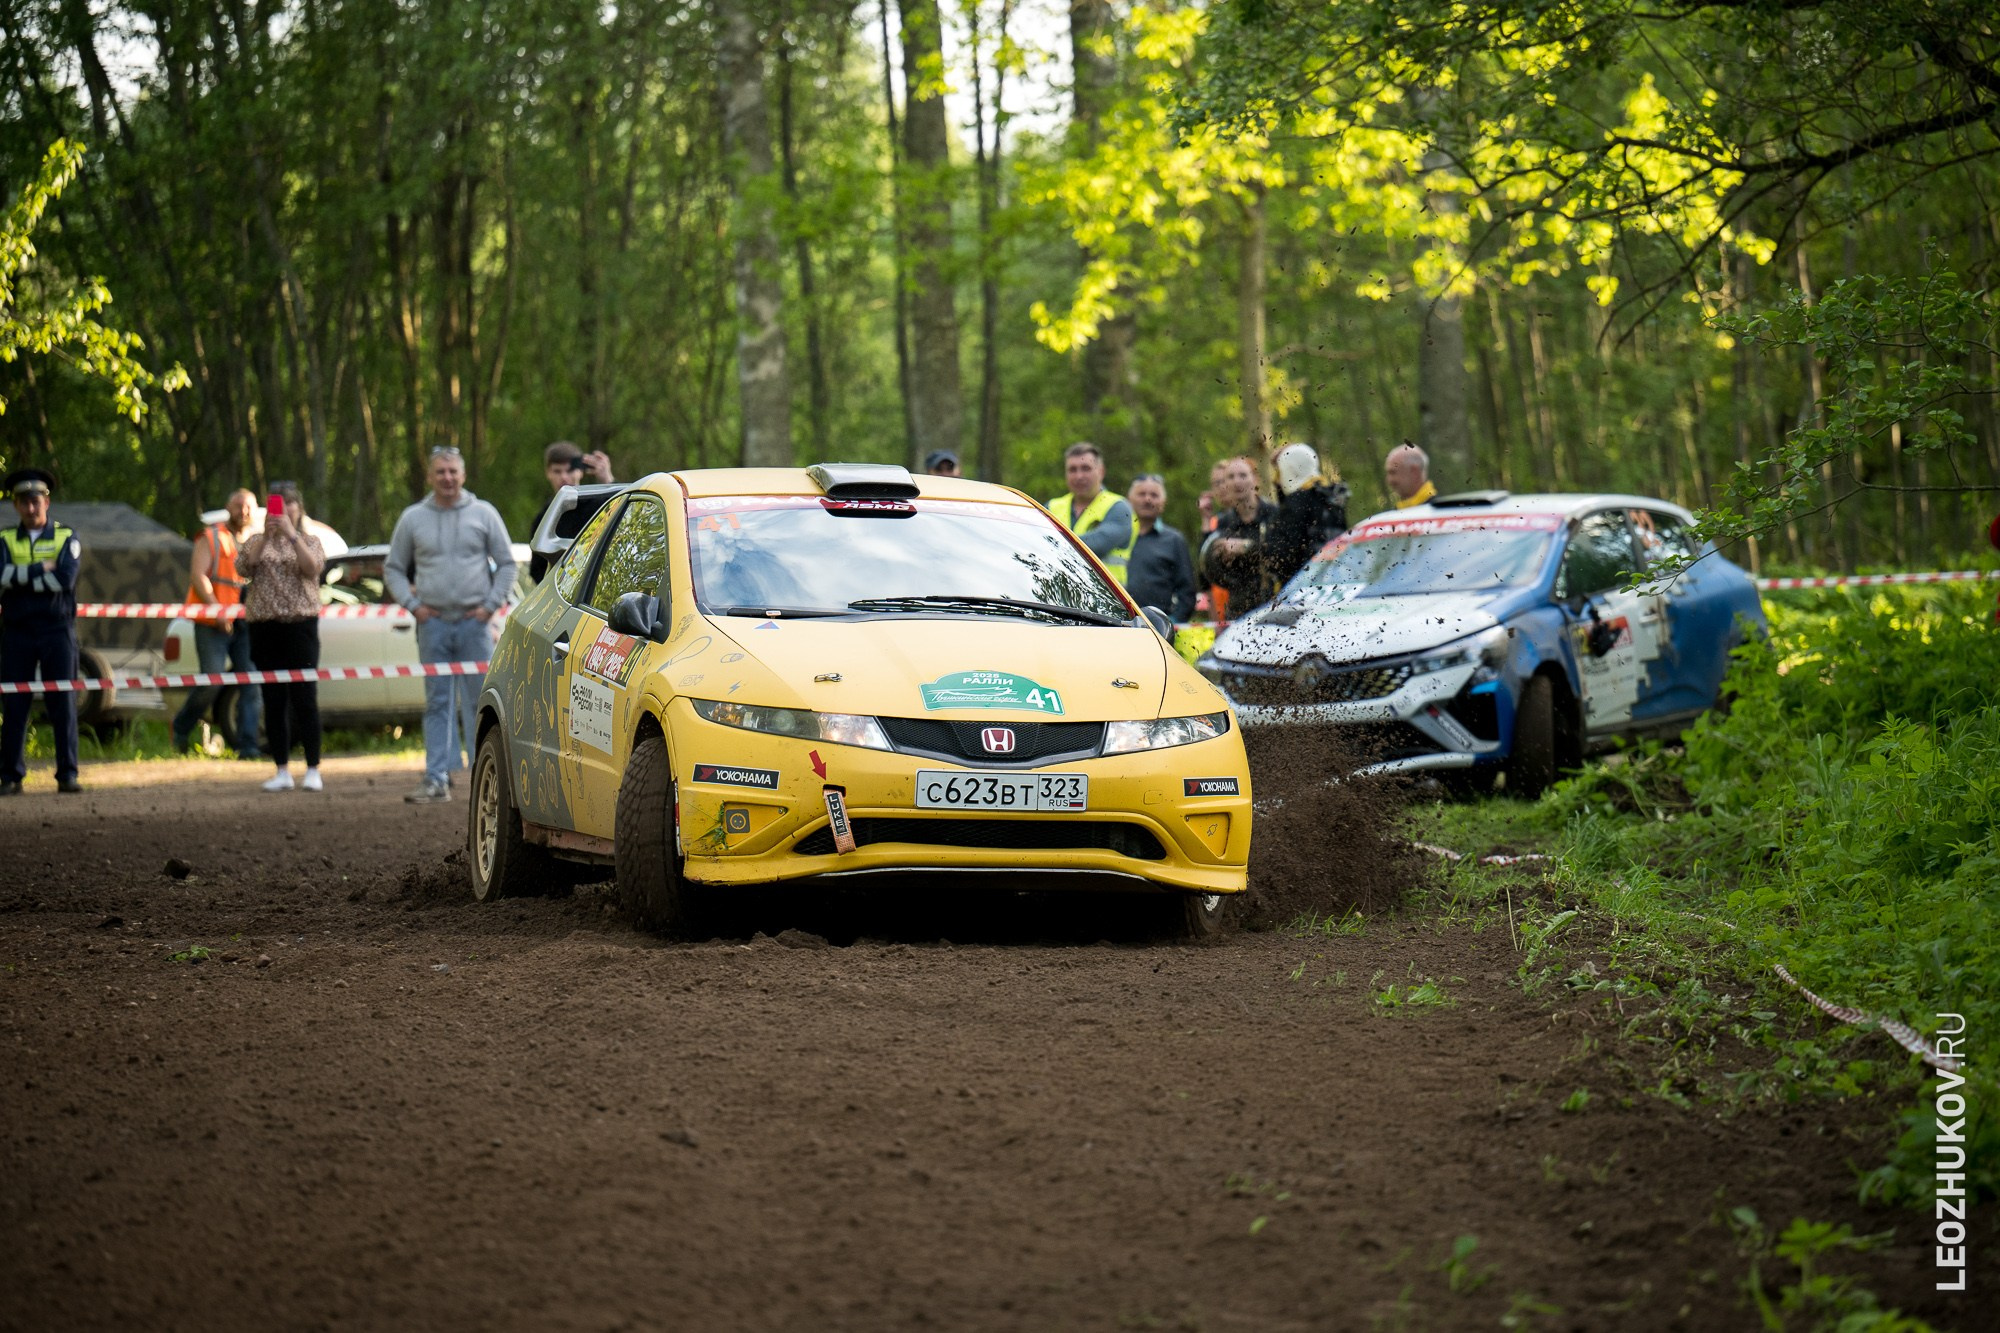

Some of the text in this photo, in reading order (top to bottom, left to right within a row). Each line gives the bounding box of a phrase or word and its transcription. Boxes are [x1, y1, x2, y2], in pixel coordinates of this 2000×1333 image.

[697, 513, 740, 532] 41
[620, 644, 643, 683] 41
[1026, 688, 1061, 712] 41
[716, 769, 772, 785] YOKOHAMA
[1200, 781, 1236, 792] YOKOHAMA
[1041, 778, 1080, 798] 323
[830, 796, 844, 826] LUKE
[1049, 799, 1069, 807] RUS
